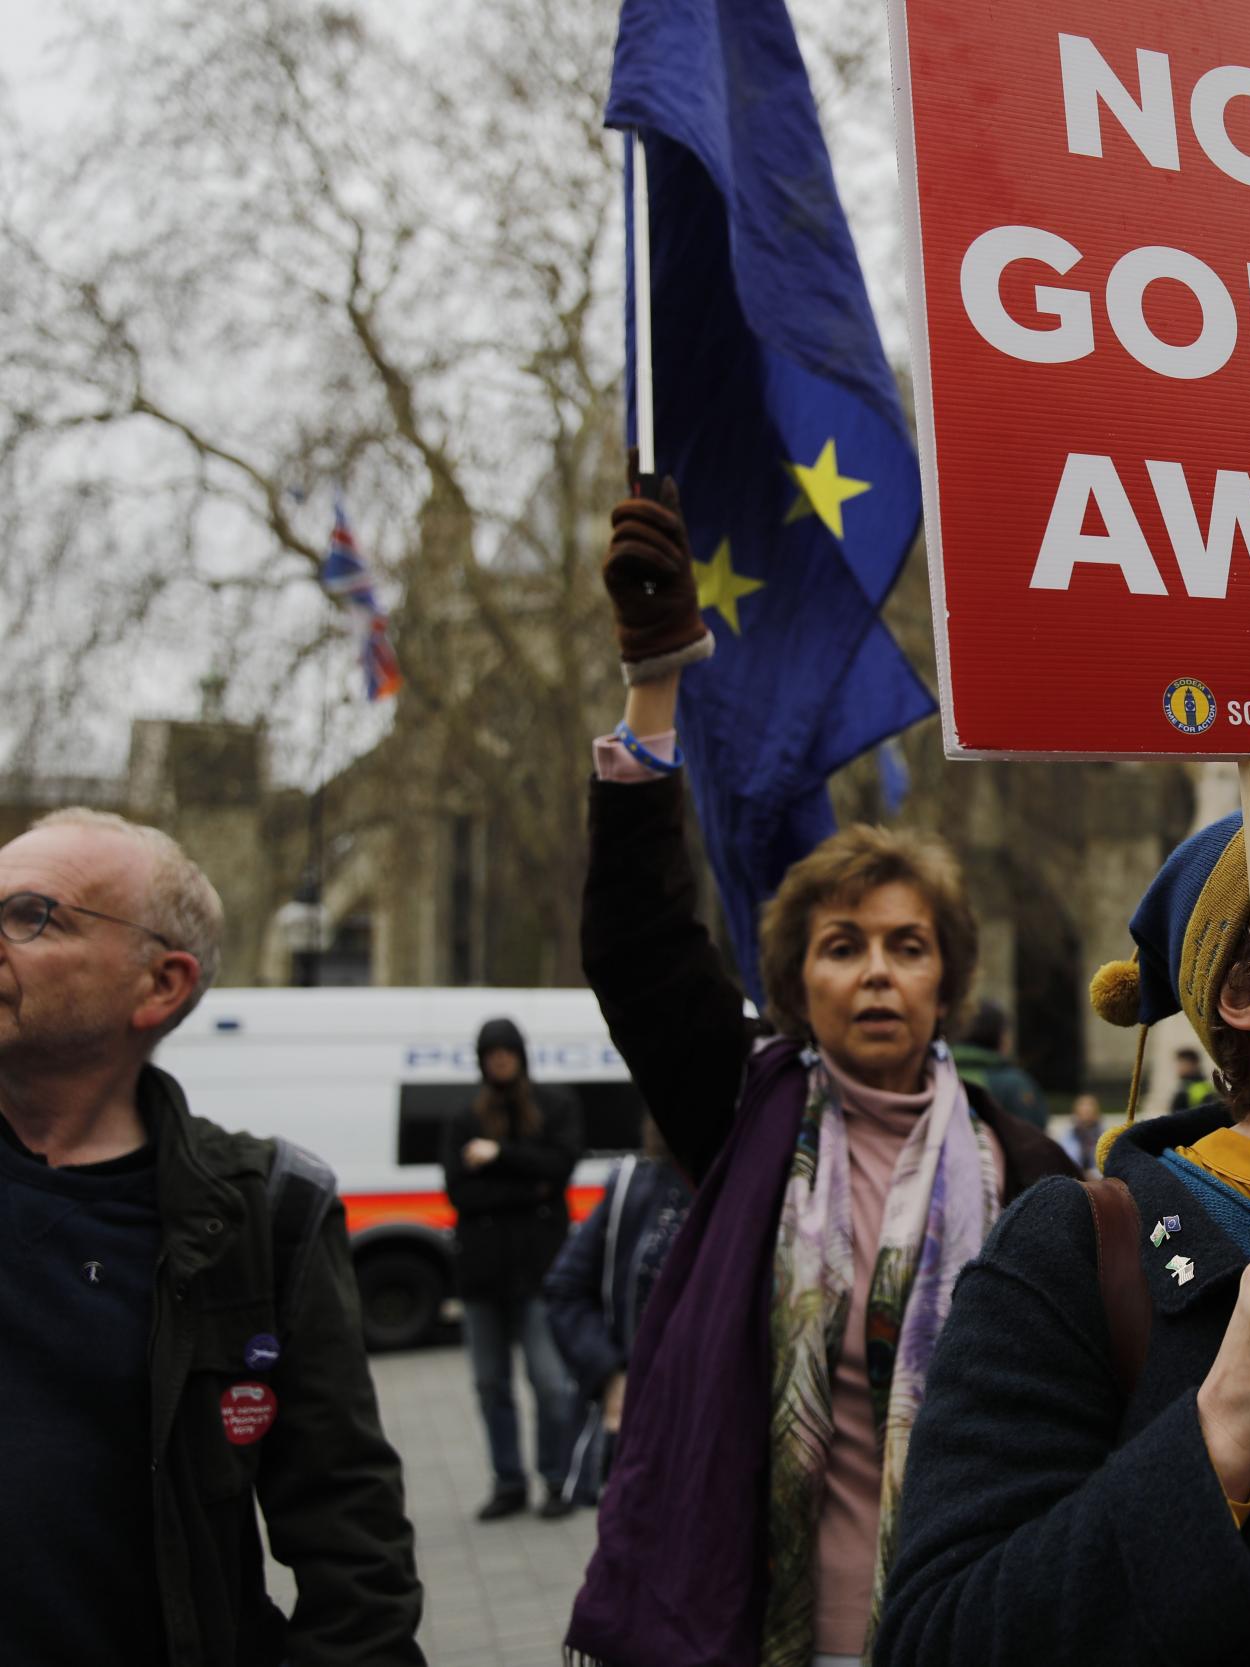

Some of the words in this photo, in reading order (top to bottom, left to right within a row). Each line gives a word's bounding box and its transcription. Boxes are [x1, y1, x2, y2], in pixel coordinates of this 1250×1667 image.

[1173, 679, 1205, 691] SODEM
[1165, 704, 1178, 725] TIME
[1178, 723, 1196, 733] FOR
[1197, 704, 1216, 732] ACTION
